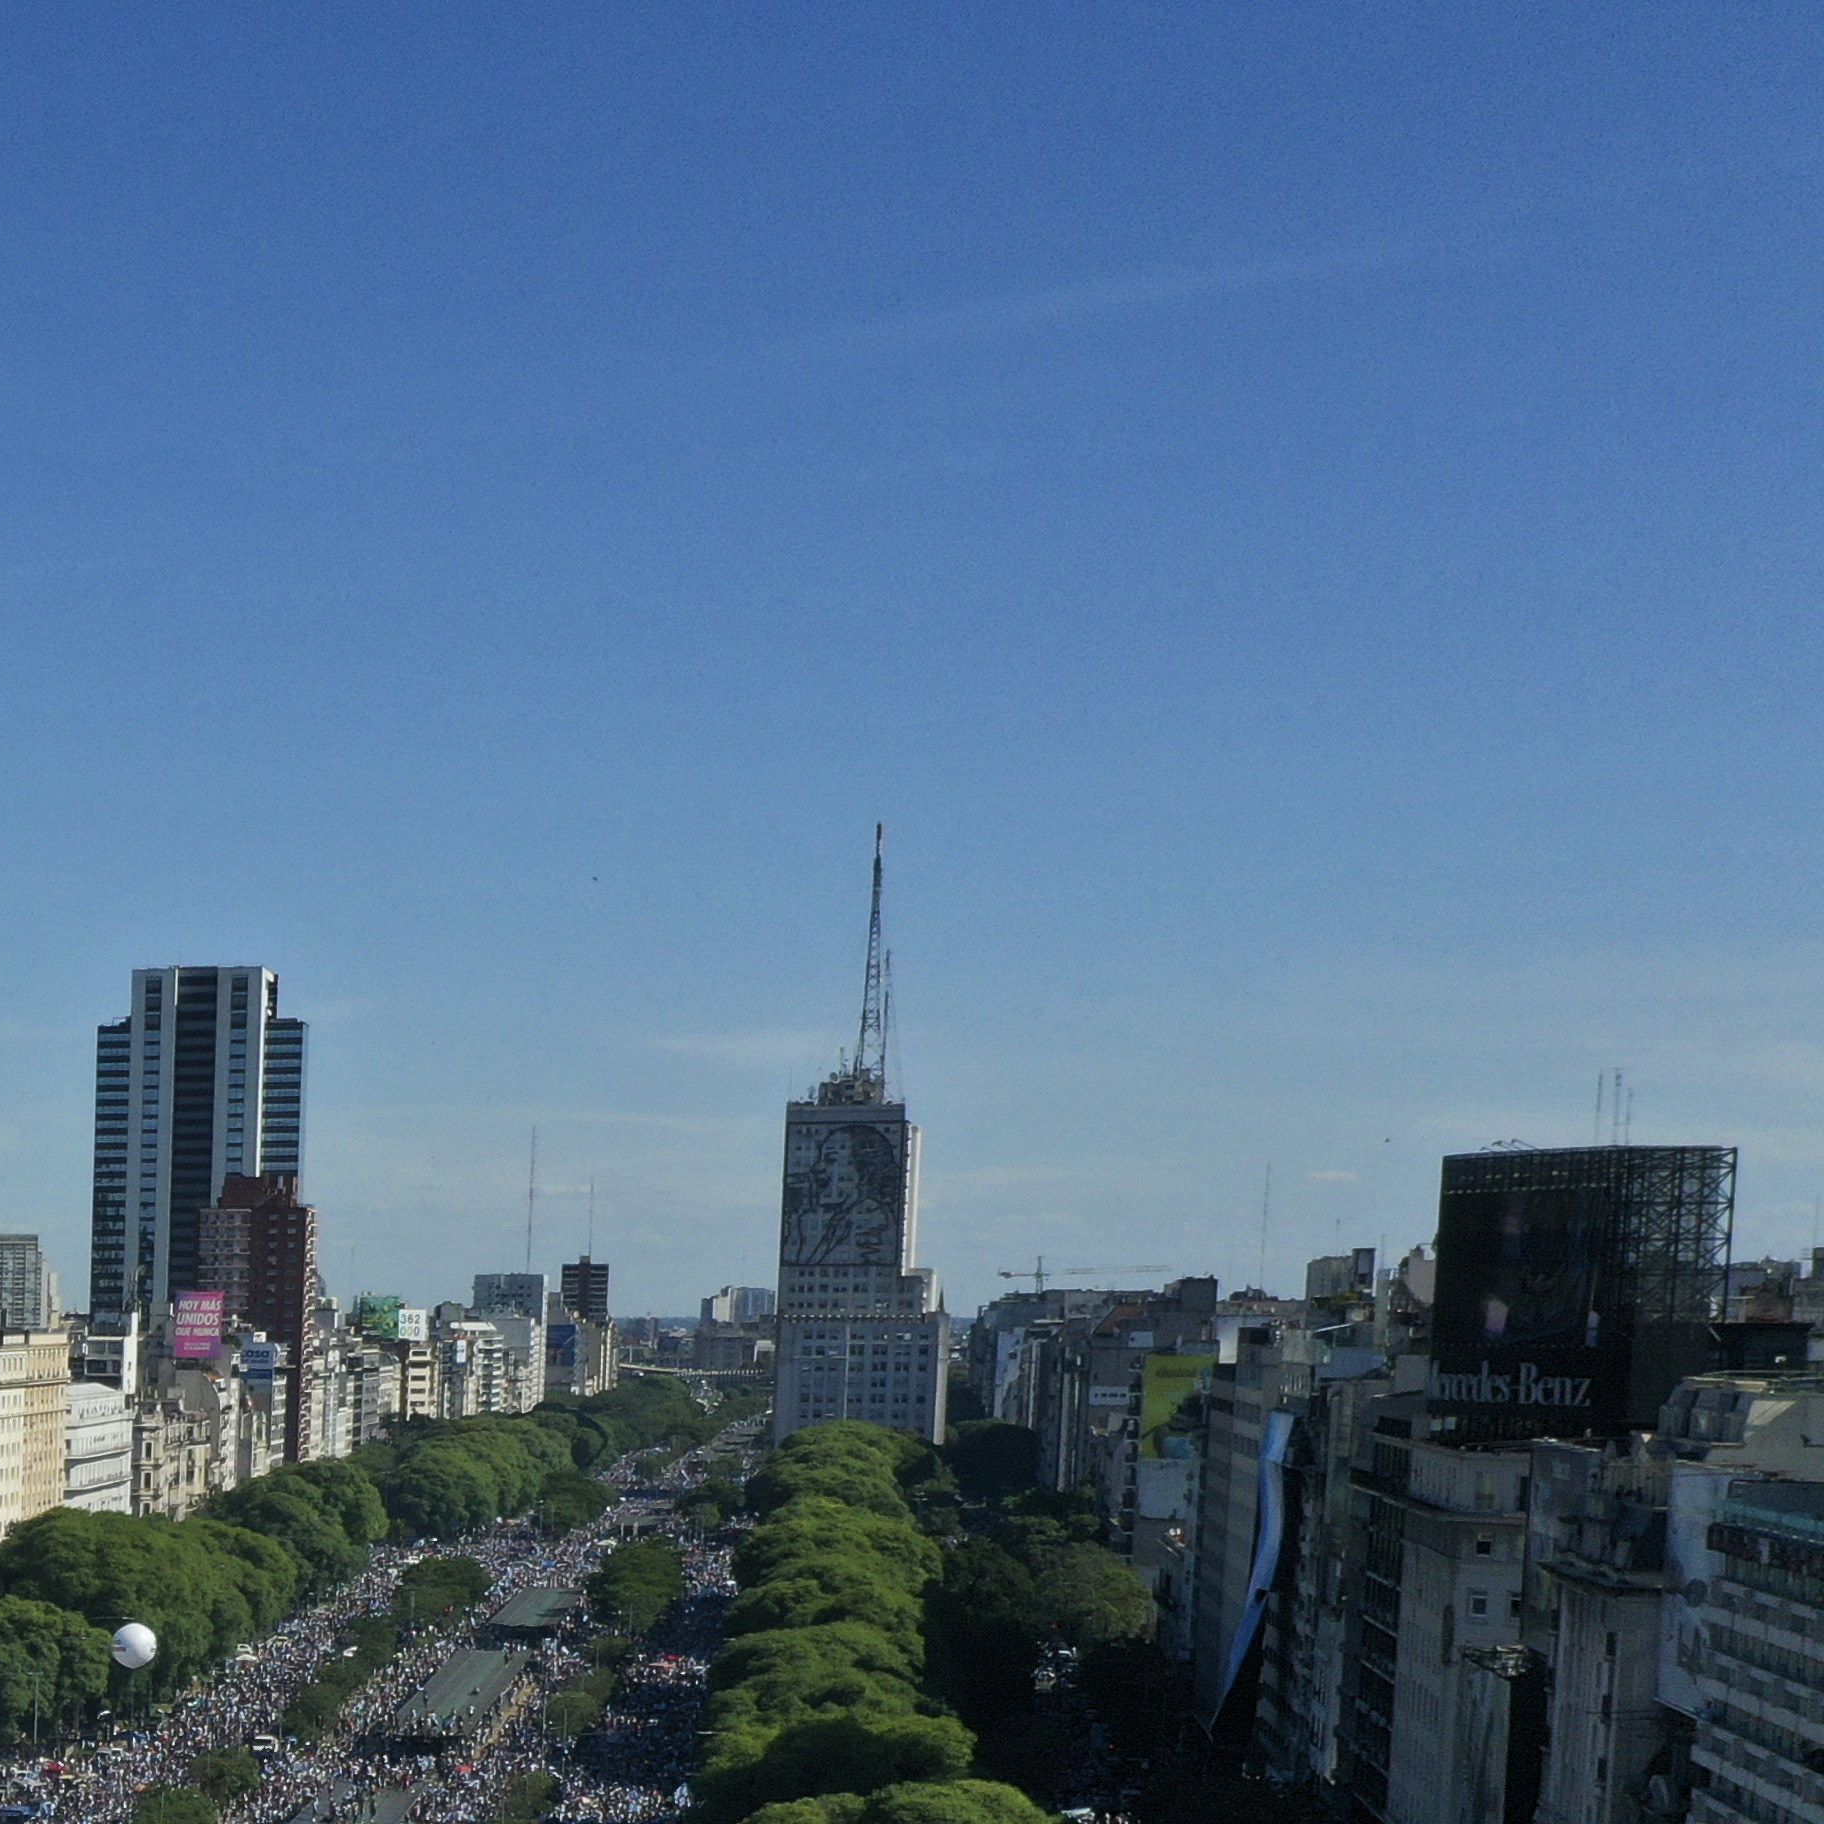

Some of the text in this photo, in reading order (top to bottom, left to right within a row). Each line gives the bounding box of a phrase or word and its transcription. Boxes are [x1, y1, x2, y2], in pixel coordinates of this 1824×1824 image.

[178, 1297, 221, 1311] HOY MÁS
[176, 1312, 219, 1325] UNIDOS
[399, 1313, 420, 1325] 362
[175, 1326, 219, 1336] QUE NUNCA
